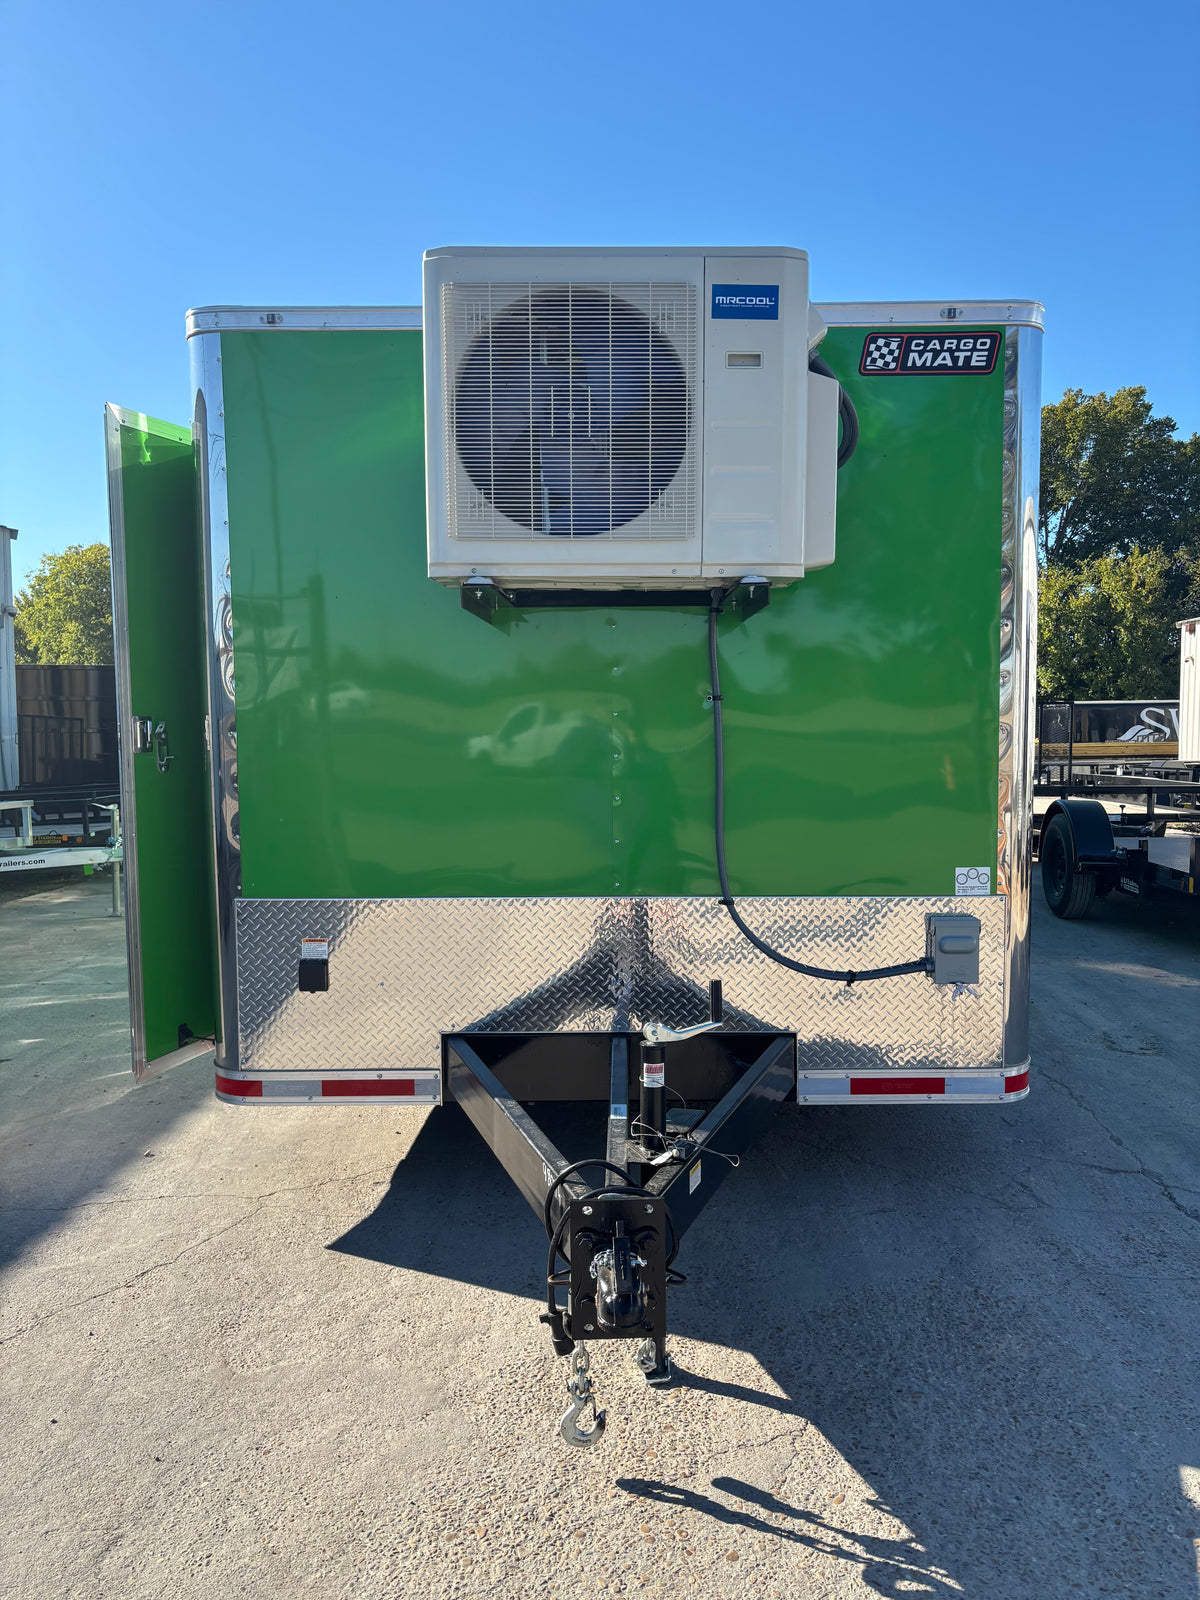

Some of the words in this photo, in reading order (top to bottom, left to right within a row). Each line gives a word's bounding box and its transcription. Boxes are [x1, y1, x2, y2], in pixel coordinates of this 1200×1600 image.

[715, 296, 775, 305] MRCOOL
[910, 338, 991, 351] CARGO
[907, 351, 989, 367] MATE
